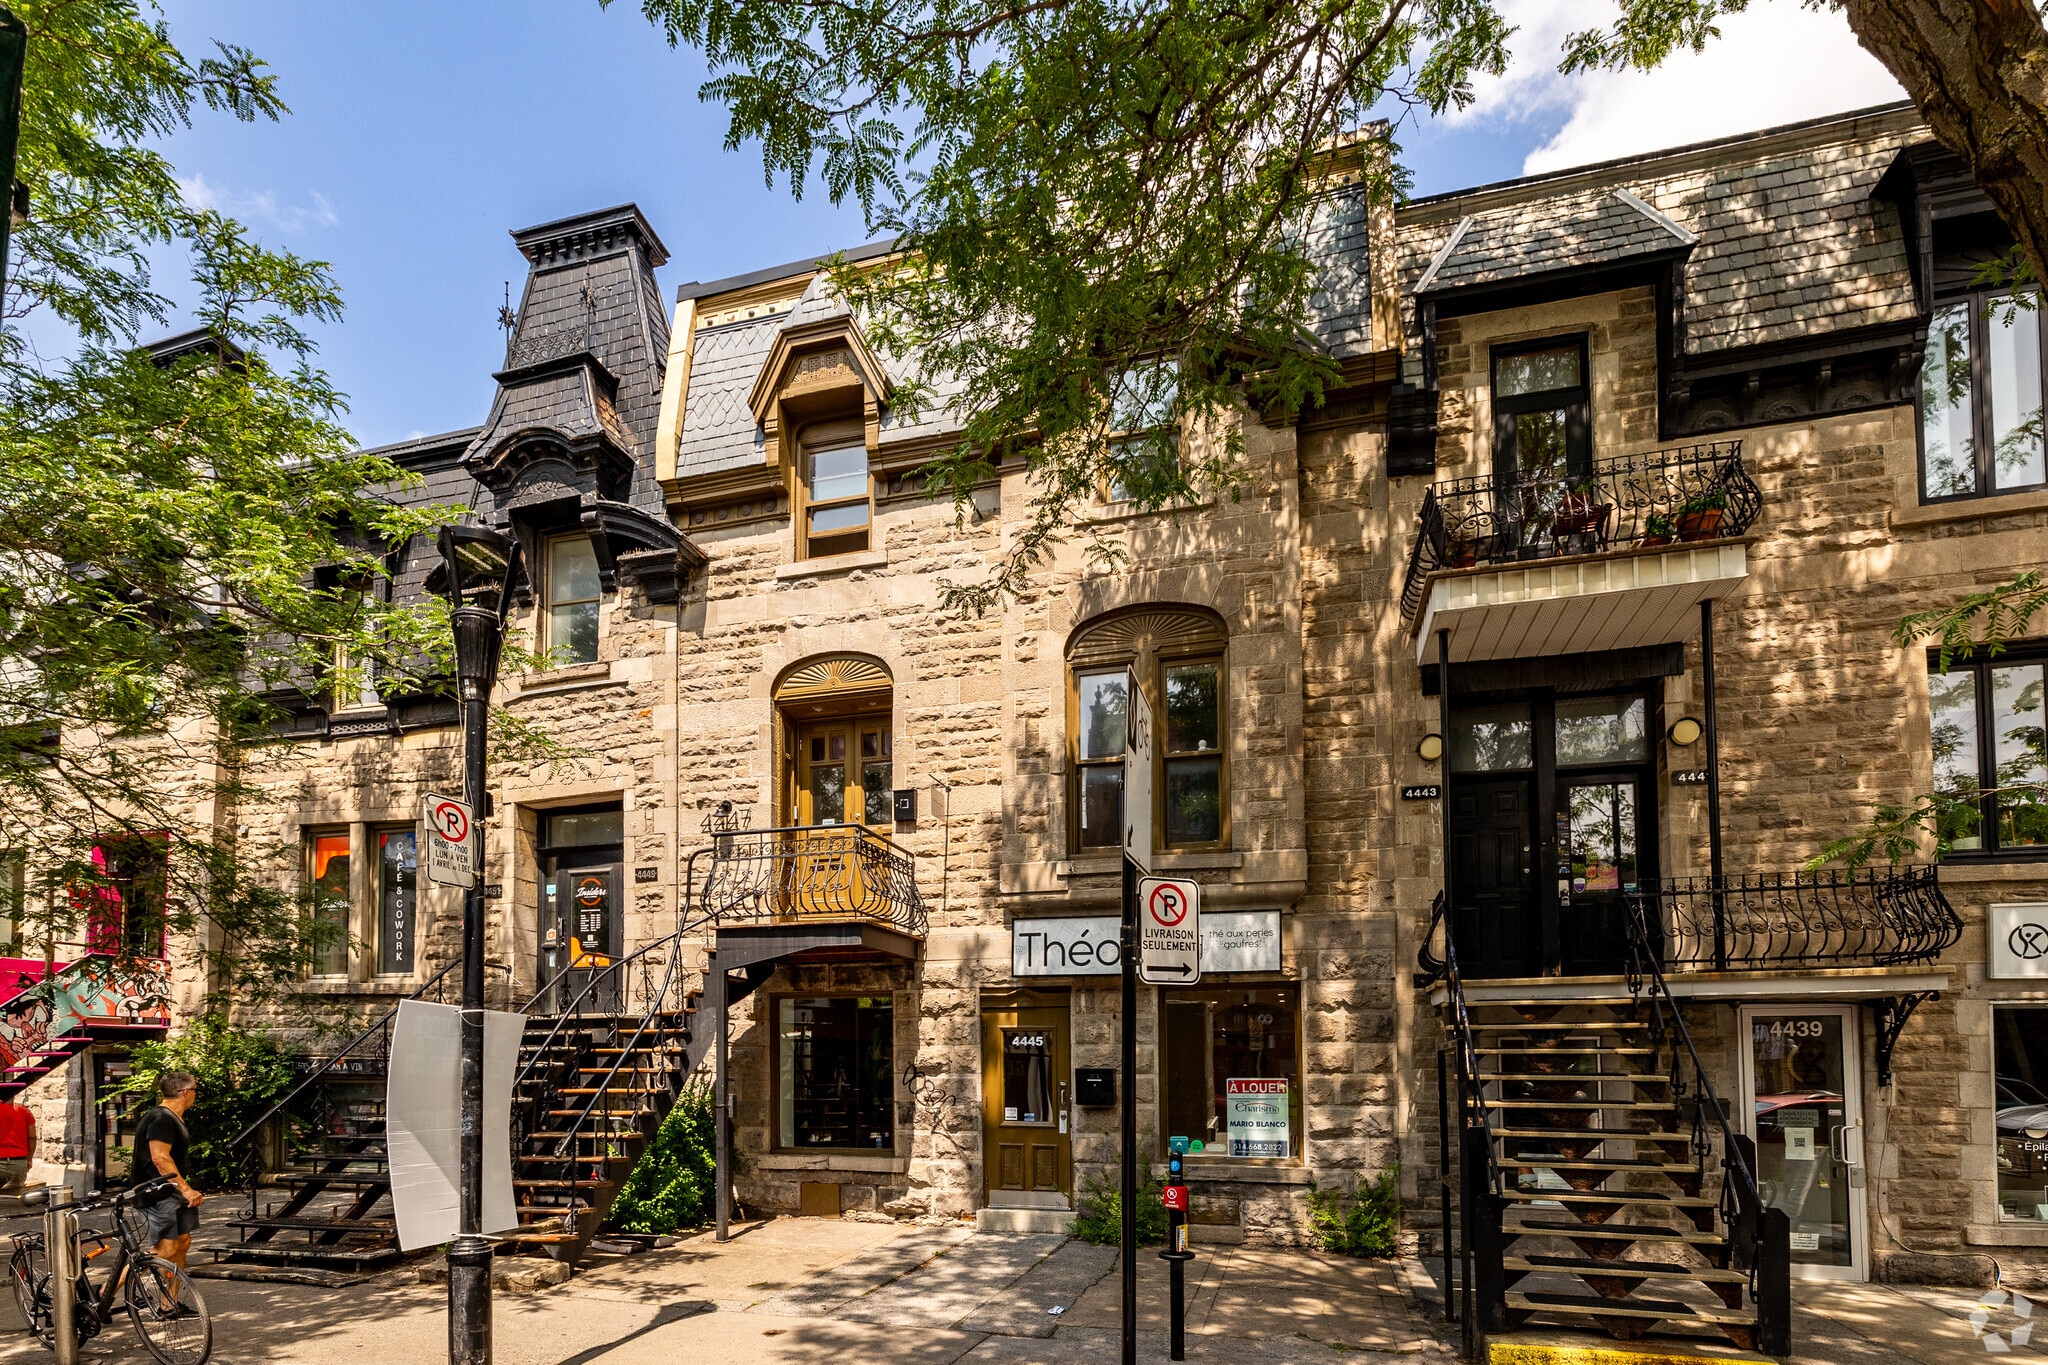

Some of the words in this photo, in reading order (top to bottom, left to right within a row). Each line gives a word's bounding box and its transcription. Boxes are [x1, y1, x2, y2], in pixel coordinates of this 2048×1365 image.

[1679, 772, 1708, 782] 444
[1406, 787, 1437, 798] 4443
[700, 807, 752, 833] 4447
[434, 838, 449, 850] 6h00
[454, 843, 468, 855] 7h00
[396, 842, 404, 882] CAFÉ
[435, 849, 448, 860] LUN
[456, 853, 469, 864] VEN
[436, 859, 451, 870] AVRIL
[396, 886, 403, 895] &
[575, 886, 607, 898] Insiders
[395, 899, 404, 961] COWORK
[1145, 928, 1194, 940] LIVRAISON
[1209, 929, 1224, 938] thé
[1226, 930, 1244, 938] aux
[1246, 928, 1274, 939] perles
[1142, 940, 1197, 951] SEULEMENT
[1223, 939, 1259, 950] gaufres
[1770, 1021, 1823, 1037] 4439
[1012, 1036, 1044, 1047] 4445
[1229, 1081, 1239, 1093] À
[1242, 1082, 1286, 1093] LOUER
[1235, 1103, 1280, 1113] Charisma
